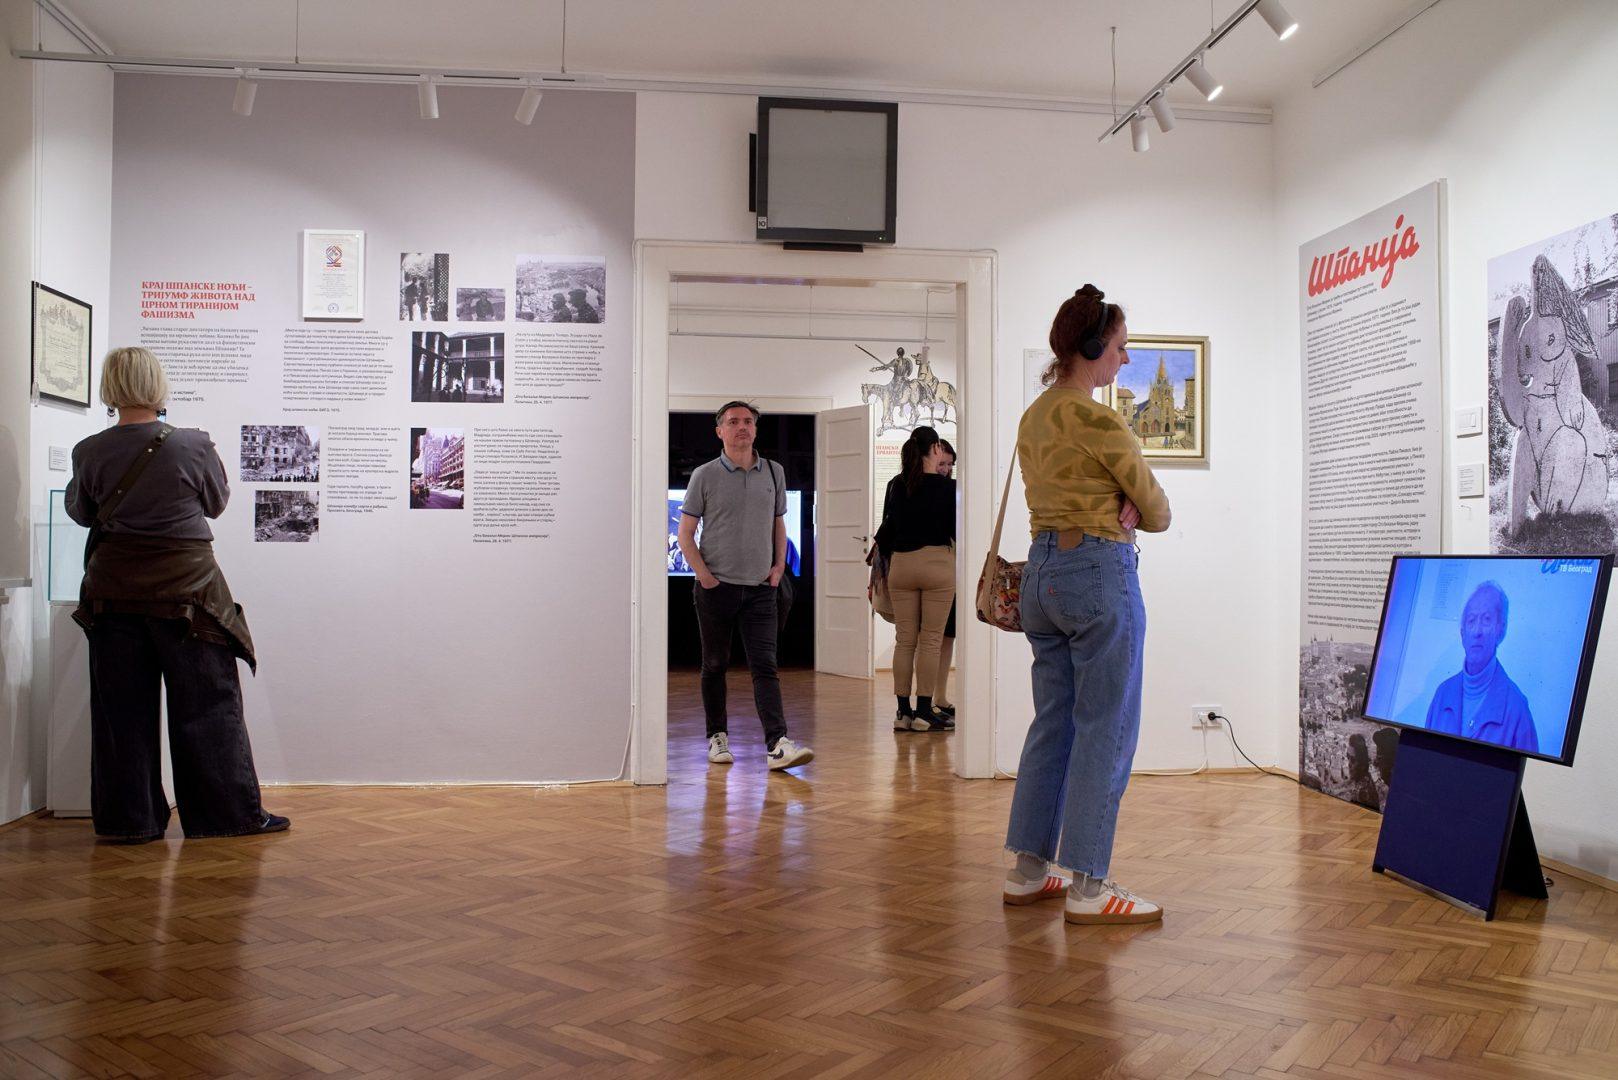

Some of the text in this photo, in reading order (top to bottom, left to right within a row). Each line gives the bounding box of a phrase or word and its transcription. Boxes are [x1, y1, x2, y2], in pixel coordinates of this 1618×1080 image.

[1308, 214, 1420, 297] Шпанија
[142, 281, 164, 290] КРАЈ
[166, 282, 215, 291] ШПАНСКЕ
[217, 283, 246, 291] НОЋИ
[142, 291, 256, 302] ТРИЈУМФ ЖИВОТА НАД
[141, 300, 239, 311] ЦРНОМ ТИРАНИЈОМ
[141, 310, 195, 320] ФАШИЗМА
[1568, 564, 1592, 575] Београд
